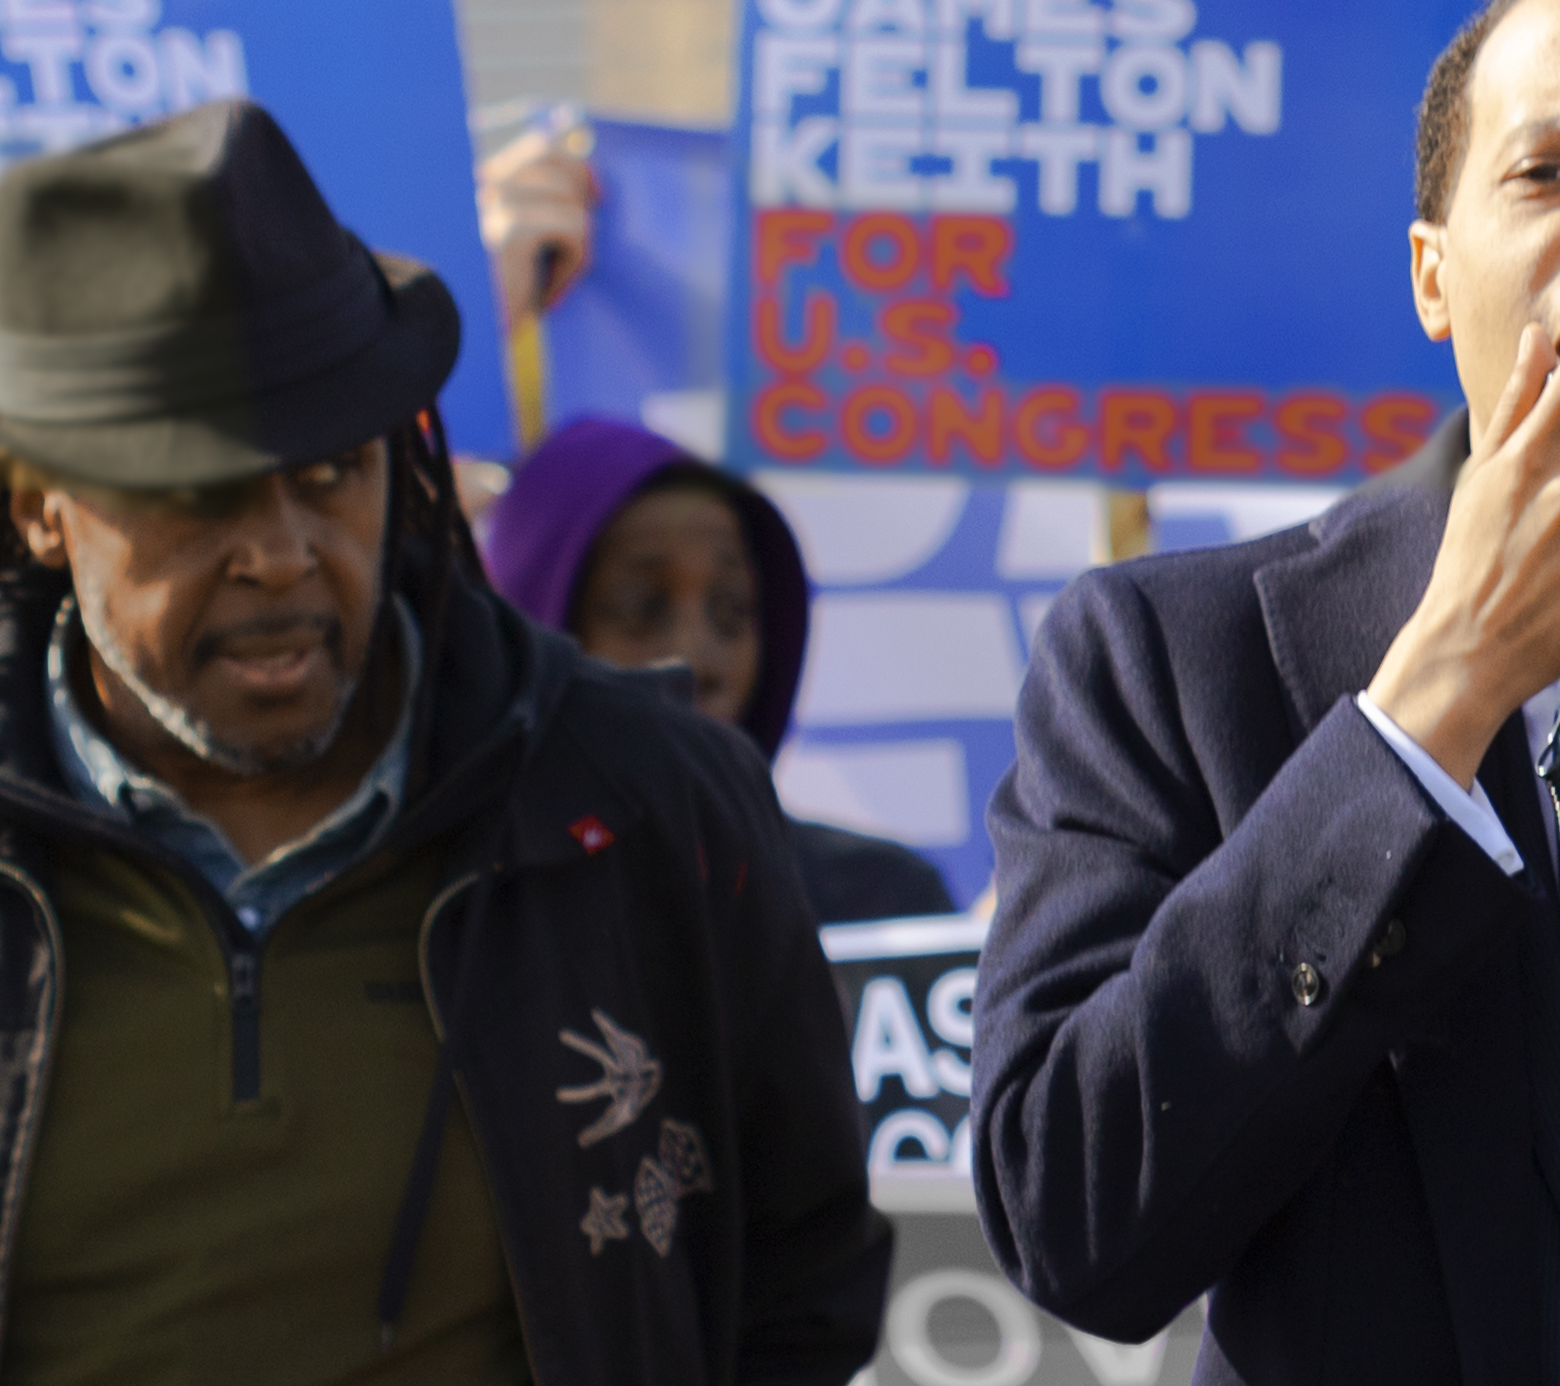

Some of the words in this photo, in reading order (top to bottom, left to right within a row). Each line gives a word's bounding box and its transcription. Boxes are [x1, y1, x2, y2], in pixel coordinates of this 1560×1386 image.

[749, 30, 1285, 136] FELTON
[749, 113, 1193, 219] KEITH
[751, 207, 1015, 298] FOR
[752, 289, 1000, 380] U.S.
[750, 380, 1438, 477] CONGRESS
